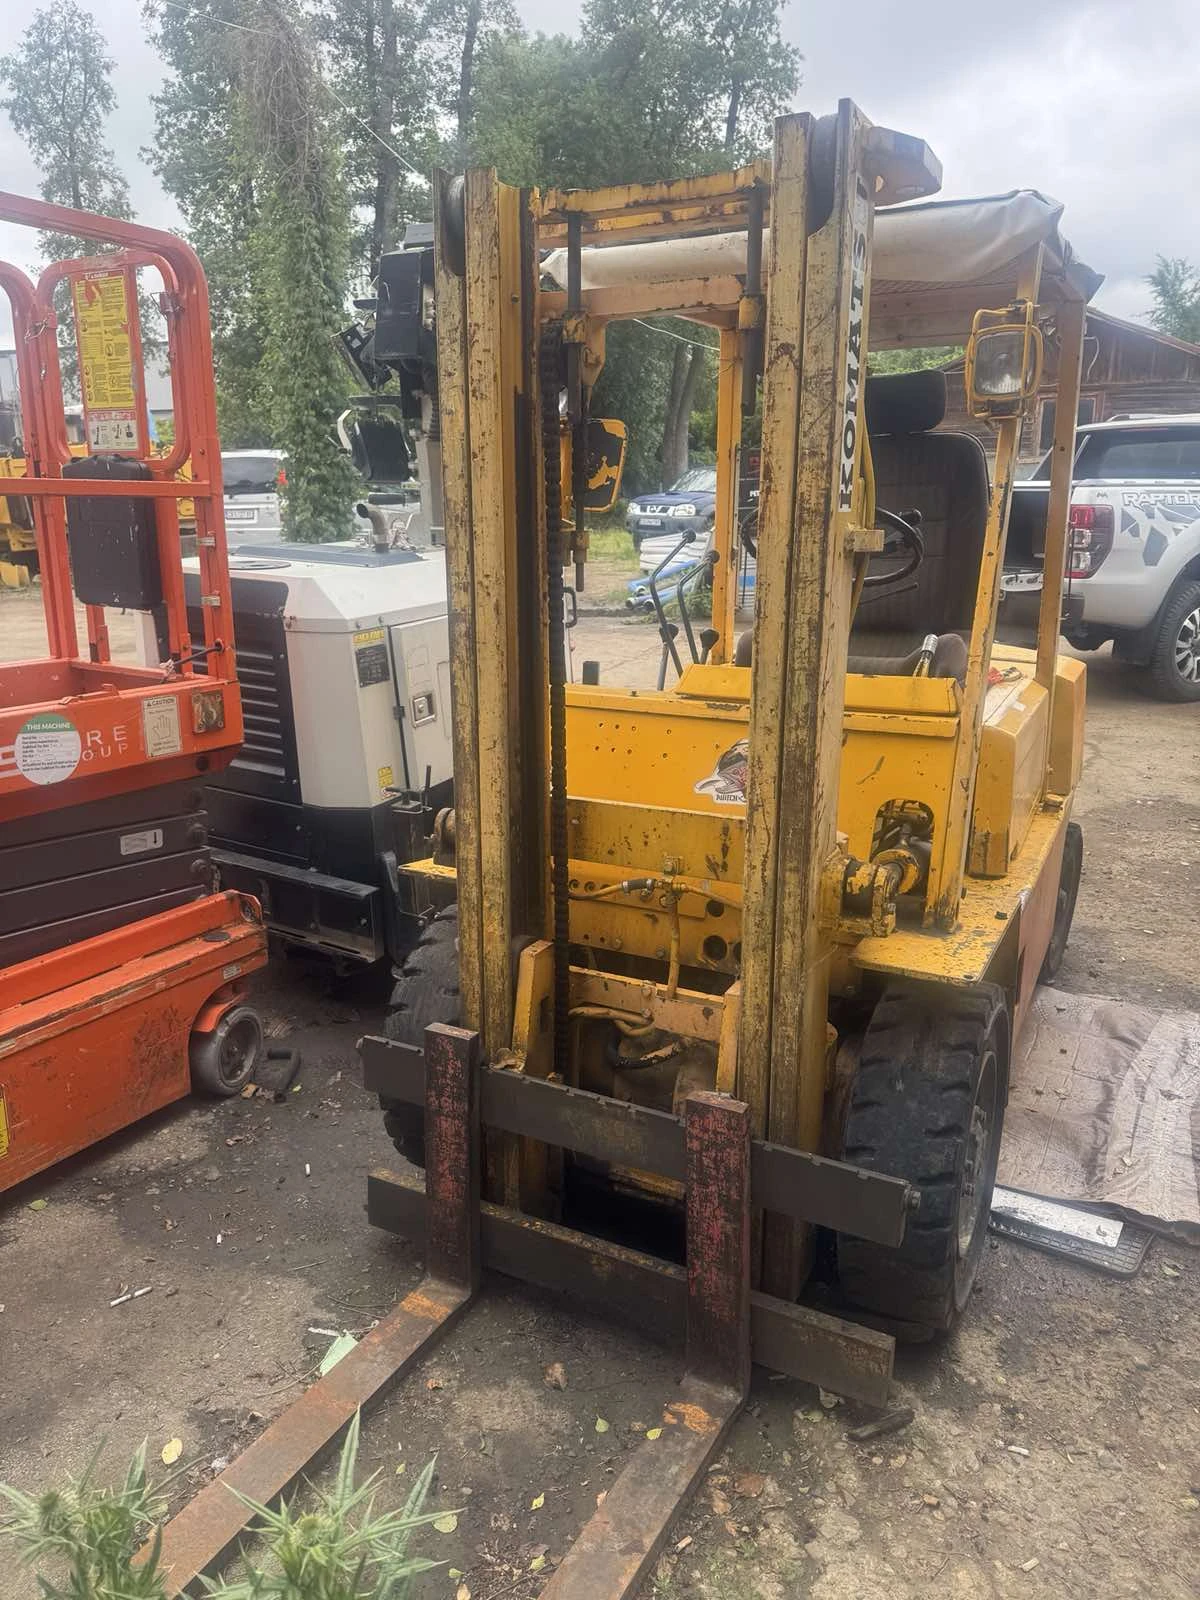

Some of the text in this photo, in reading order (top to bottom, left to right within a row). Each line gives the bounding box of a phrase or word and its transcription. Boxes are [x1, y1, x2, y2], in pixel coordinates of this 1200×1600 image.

[1122, 491, 1200, 511] RAPTOR
[151, 698, 175, 706] CAUTION
[42, 722, 71, 730] MACHINE
